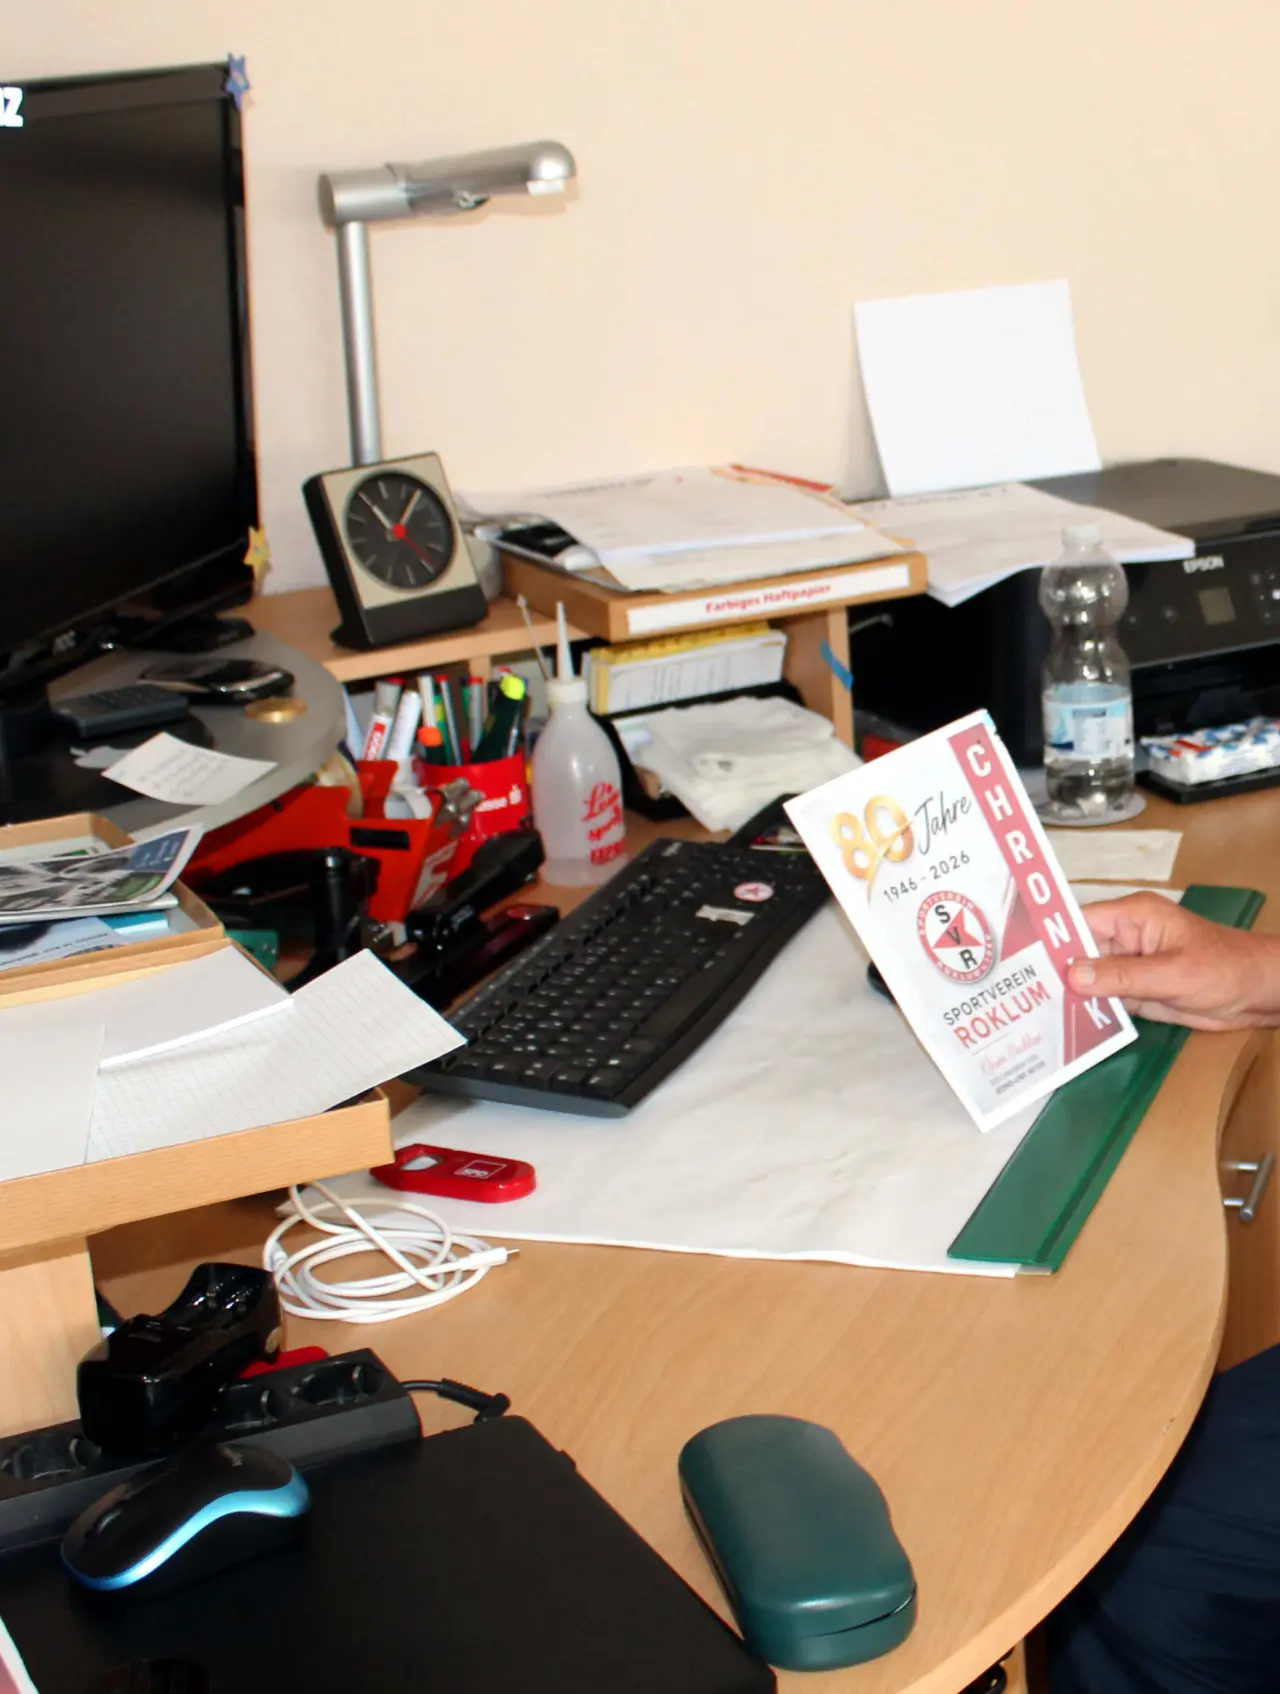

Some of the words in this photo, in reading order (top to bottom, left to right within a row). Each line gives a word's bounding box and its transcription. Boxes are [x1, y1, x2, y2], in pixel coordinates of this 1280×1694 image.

[1183, 555, 1224, 573] EPSON
[706, 596, 761, 613] Farbiges
[763, 585, 831, 605] Haftpapier
[829, 794, 915, 880] 80
[914, 790, 972, 856] Jahre
[883, 877, 918, 904] 1946
[929, 850, 970, 880] 2026
[966, 744, 1112, 1030] CHRONK
[943, 964, 1037, 1026] SPORTVEREIN
[953, 980, 1052, 1049] ROKLUM
